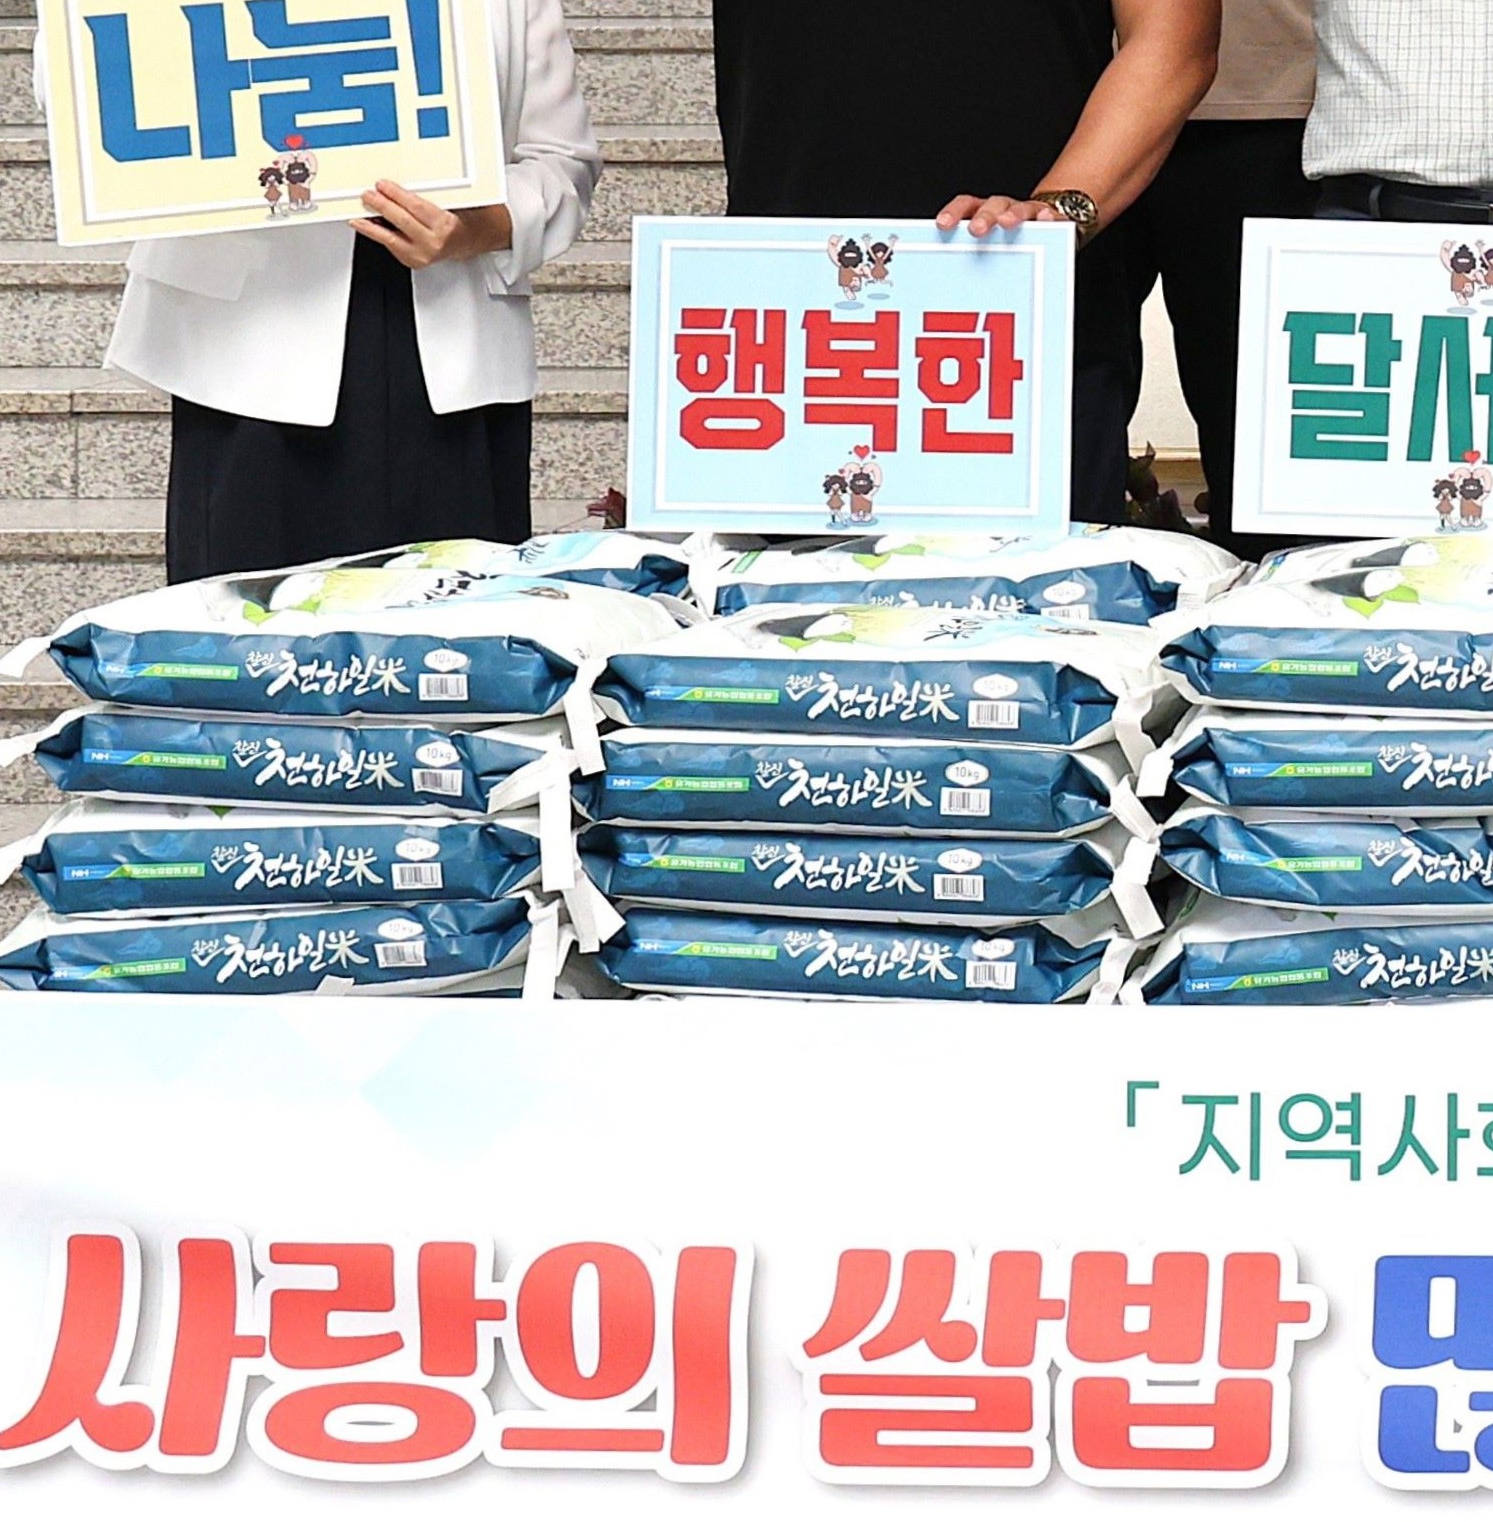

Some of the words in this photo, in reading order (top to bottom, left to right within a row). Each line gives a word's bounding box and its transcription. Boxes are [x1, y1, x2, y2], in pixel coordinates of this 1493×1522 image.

[674, 307, 1025, 455] 행복한
[264, 651, 410, 697] 천하일米
[432, 653, 460, 666] 10kg
[807, 671, 960, 723] 천하일米
[259, 746, 405, 789] 천하일米
[425, 746, 453, 760] 10kg
[953, 765, 981, 780] 10kg
[779, 757, 933, 809] 천하일米
[234, 841, 384, 890] 천하일米
[773, 842, 925, 895] 천하일米
[216, 929, 370, 983] 천하일米
[805, 931, 956, 982] 천하일米
[978, 940, 1006, 954] 10kg
[0, 1233, 737, 1468] 사랑의
[802, 1248, 1312, 1473] 쌀밥
